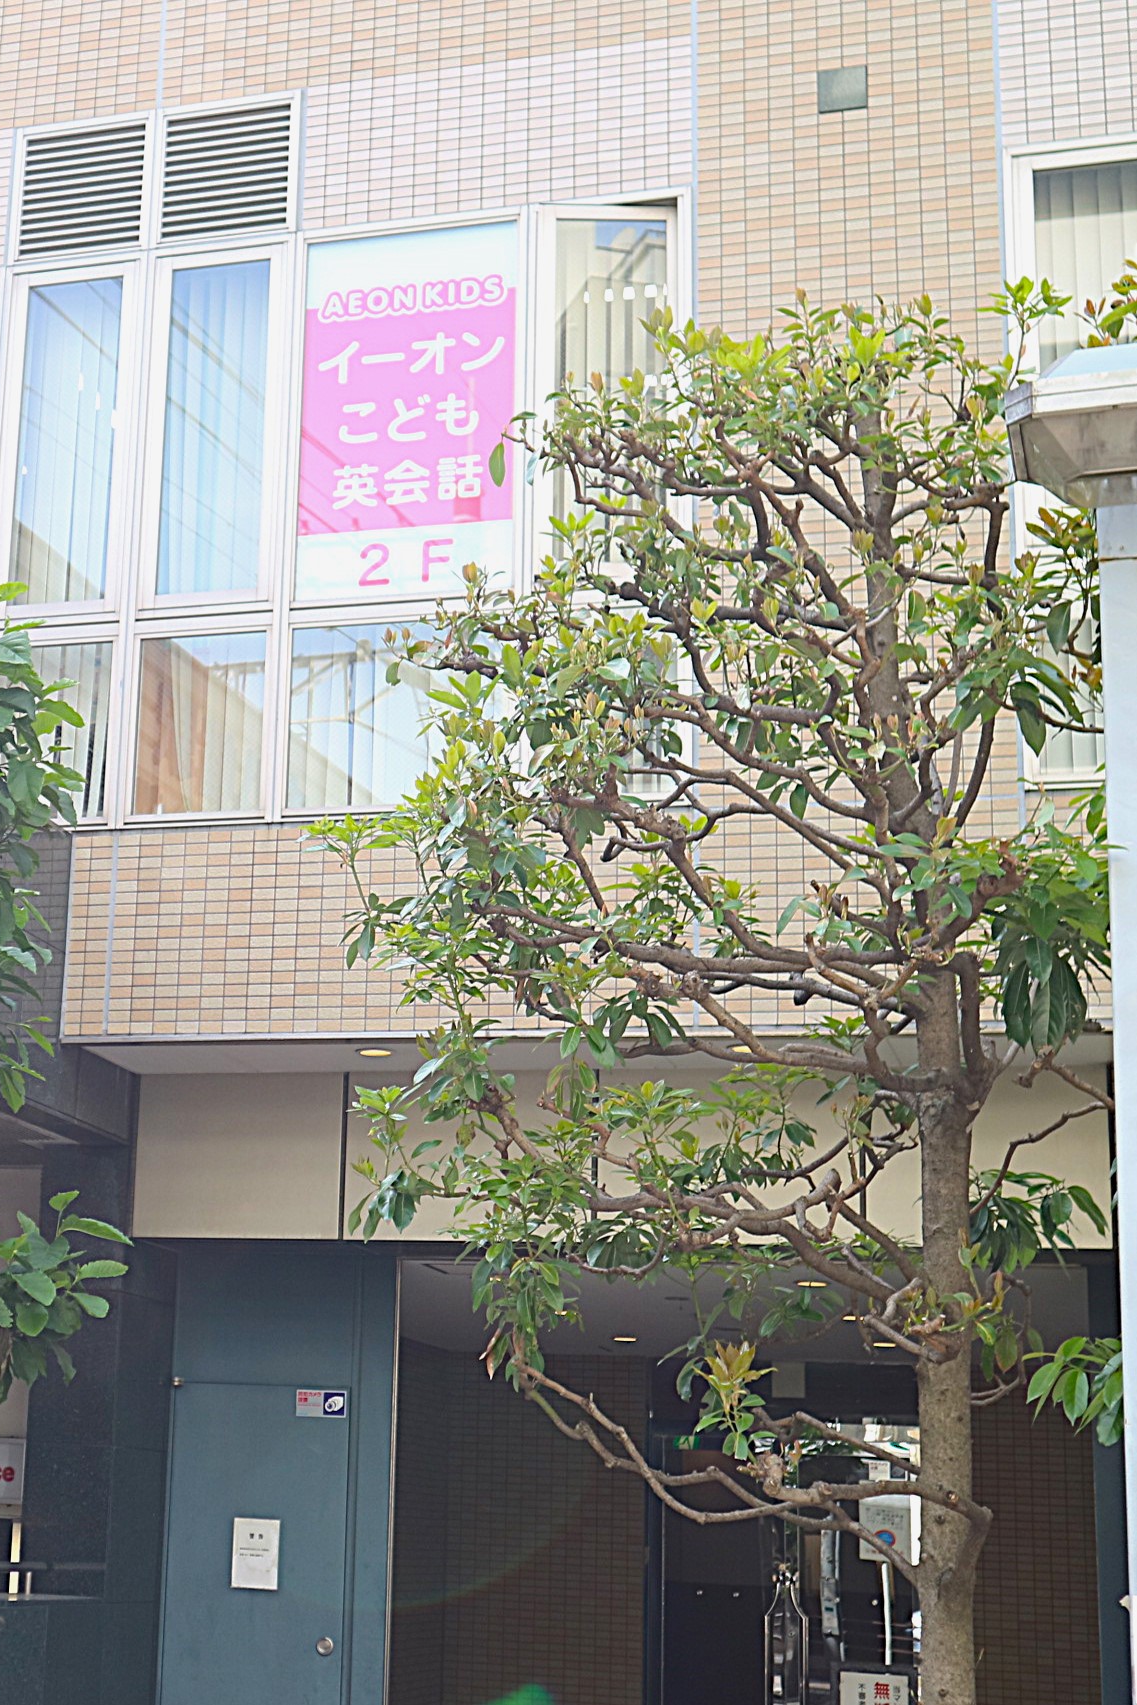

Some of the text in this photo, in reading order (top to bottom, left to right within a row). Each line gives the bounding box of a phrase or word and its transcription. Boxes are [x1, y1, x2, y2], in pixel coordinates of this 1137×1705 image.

[322, 276, 503, 318] AEON KIDS
[318, 332, 505, 385] イーオン
[338, 393, 480, 445] こども
[332, 454, 484, 510] 英会話
